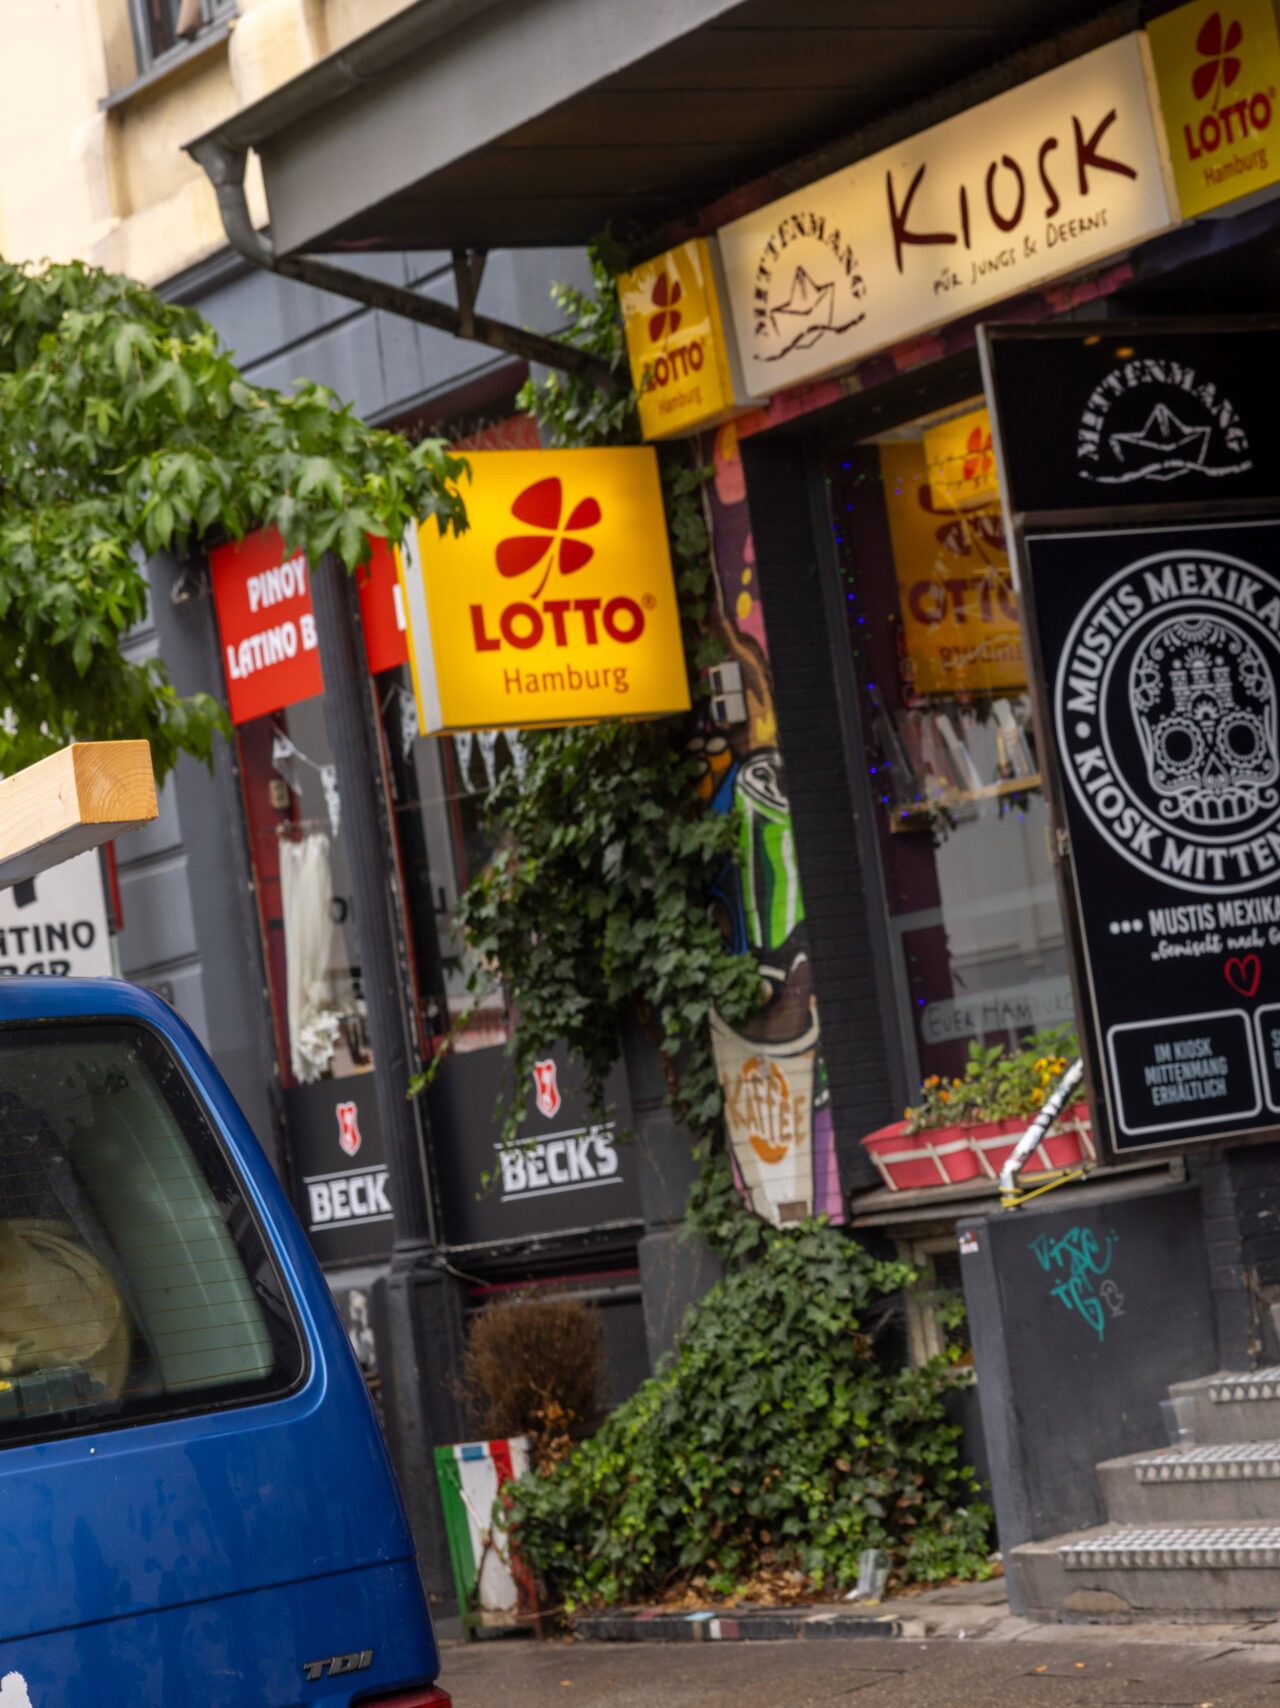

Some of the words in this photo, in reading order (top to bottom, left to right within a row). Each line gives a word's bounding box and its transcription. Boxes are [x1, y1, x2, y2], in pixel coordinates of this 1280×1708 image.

[1184, 92, 1272, 161] LOTTO
[886, 107, 1138, 275] KIOSK
[1203, 147, 1269, 188] Hamburg
[1023, 235, 1038, 259] &
[1077, 359, 1248, 461] MITTENMANG
[247, 555, 306, 613] PINOY
[227, 621, 298, 680] LATINO
[299, 613, 319, 651] B
[470, 596, 646, 653] LOTTO
[1067, 583, 1144, 715] MUSTIS
[503, 662, 630, 694] Hamburg
[1074, 746, 1162, 859] KIOSK
[1148, 903, 1216, 937] MUSTIS
[1144, 1056, 1228, 1087] MITTENMANG
[1154, 1041, 1173, 1064] IM
[1173, 1037, 1213, 1062] KIOSK
[1152, 1077, 1227, 1107] ERHÄLTLICH
[303, 1649, 374, 1682] TDI
